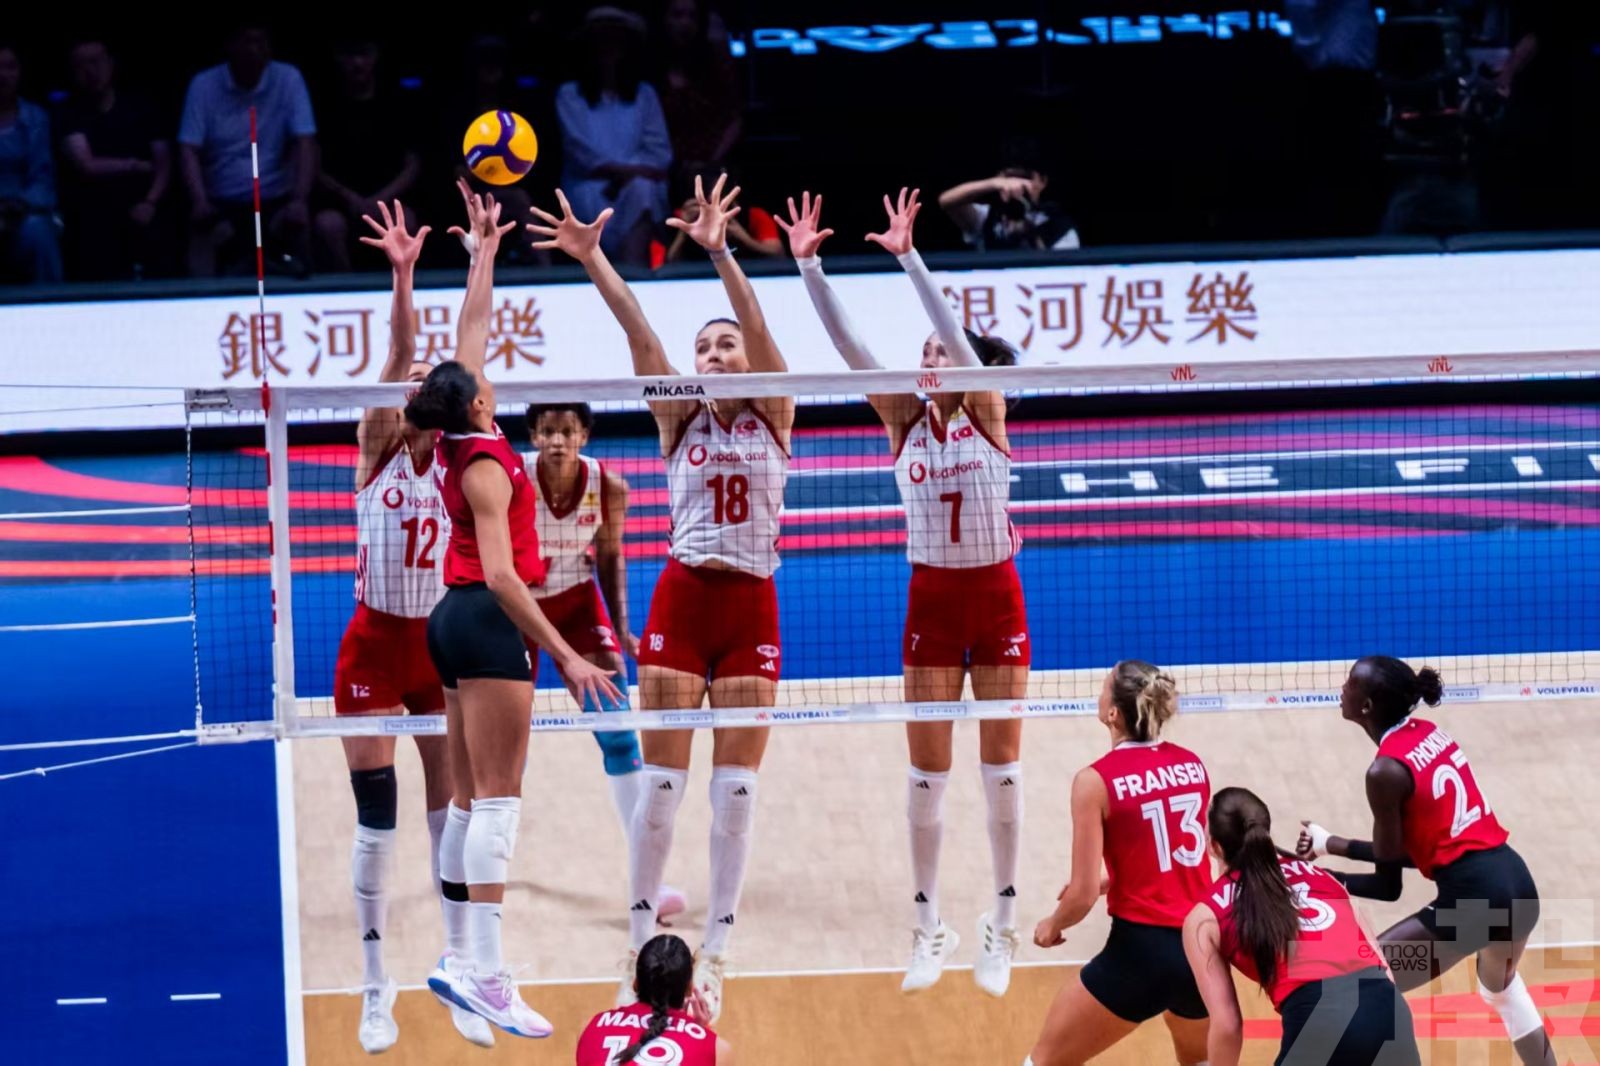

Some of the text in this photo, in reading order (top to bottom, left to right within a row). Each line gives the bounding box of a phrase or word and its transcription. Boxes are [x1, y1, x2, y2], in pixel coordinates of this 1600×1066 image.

[706, 473, 749, 525] 18
[940, 491, 963, 543] 7
[401, 516, 439, 569] 12
[649, 633, 664, 652] 18
[911, 633, 920, 651] 7
[1282, 695, 1341, 705] VOLLEYBALL
[1537, 686, 1595, 696] VOLLEYBALL
[773, 711, 830, 720] VOLLEYBALL
[1028, 703, 1085, 712] VOLLEYBALL
[1112, 762, 1206, 801] FRANSEN
[1140, 792, 1206, 873] 13
